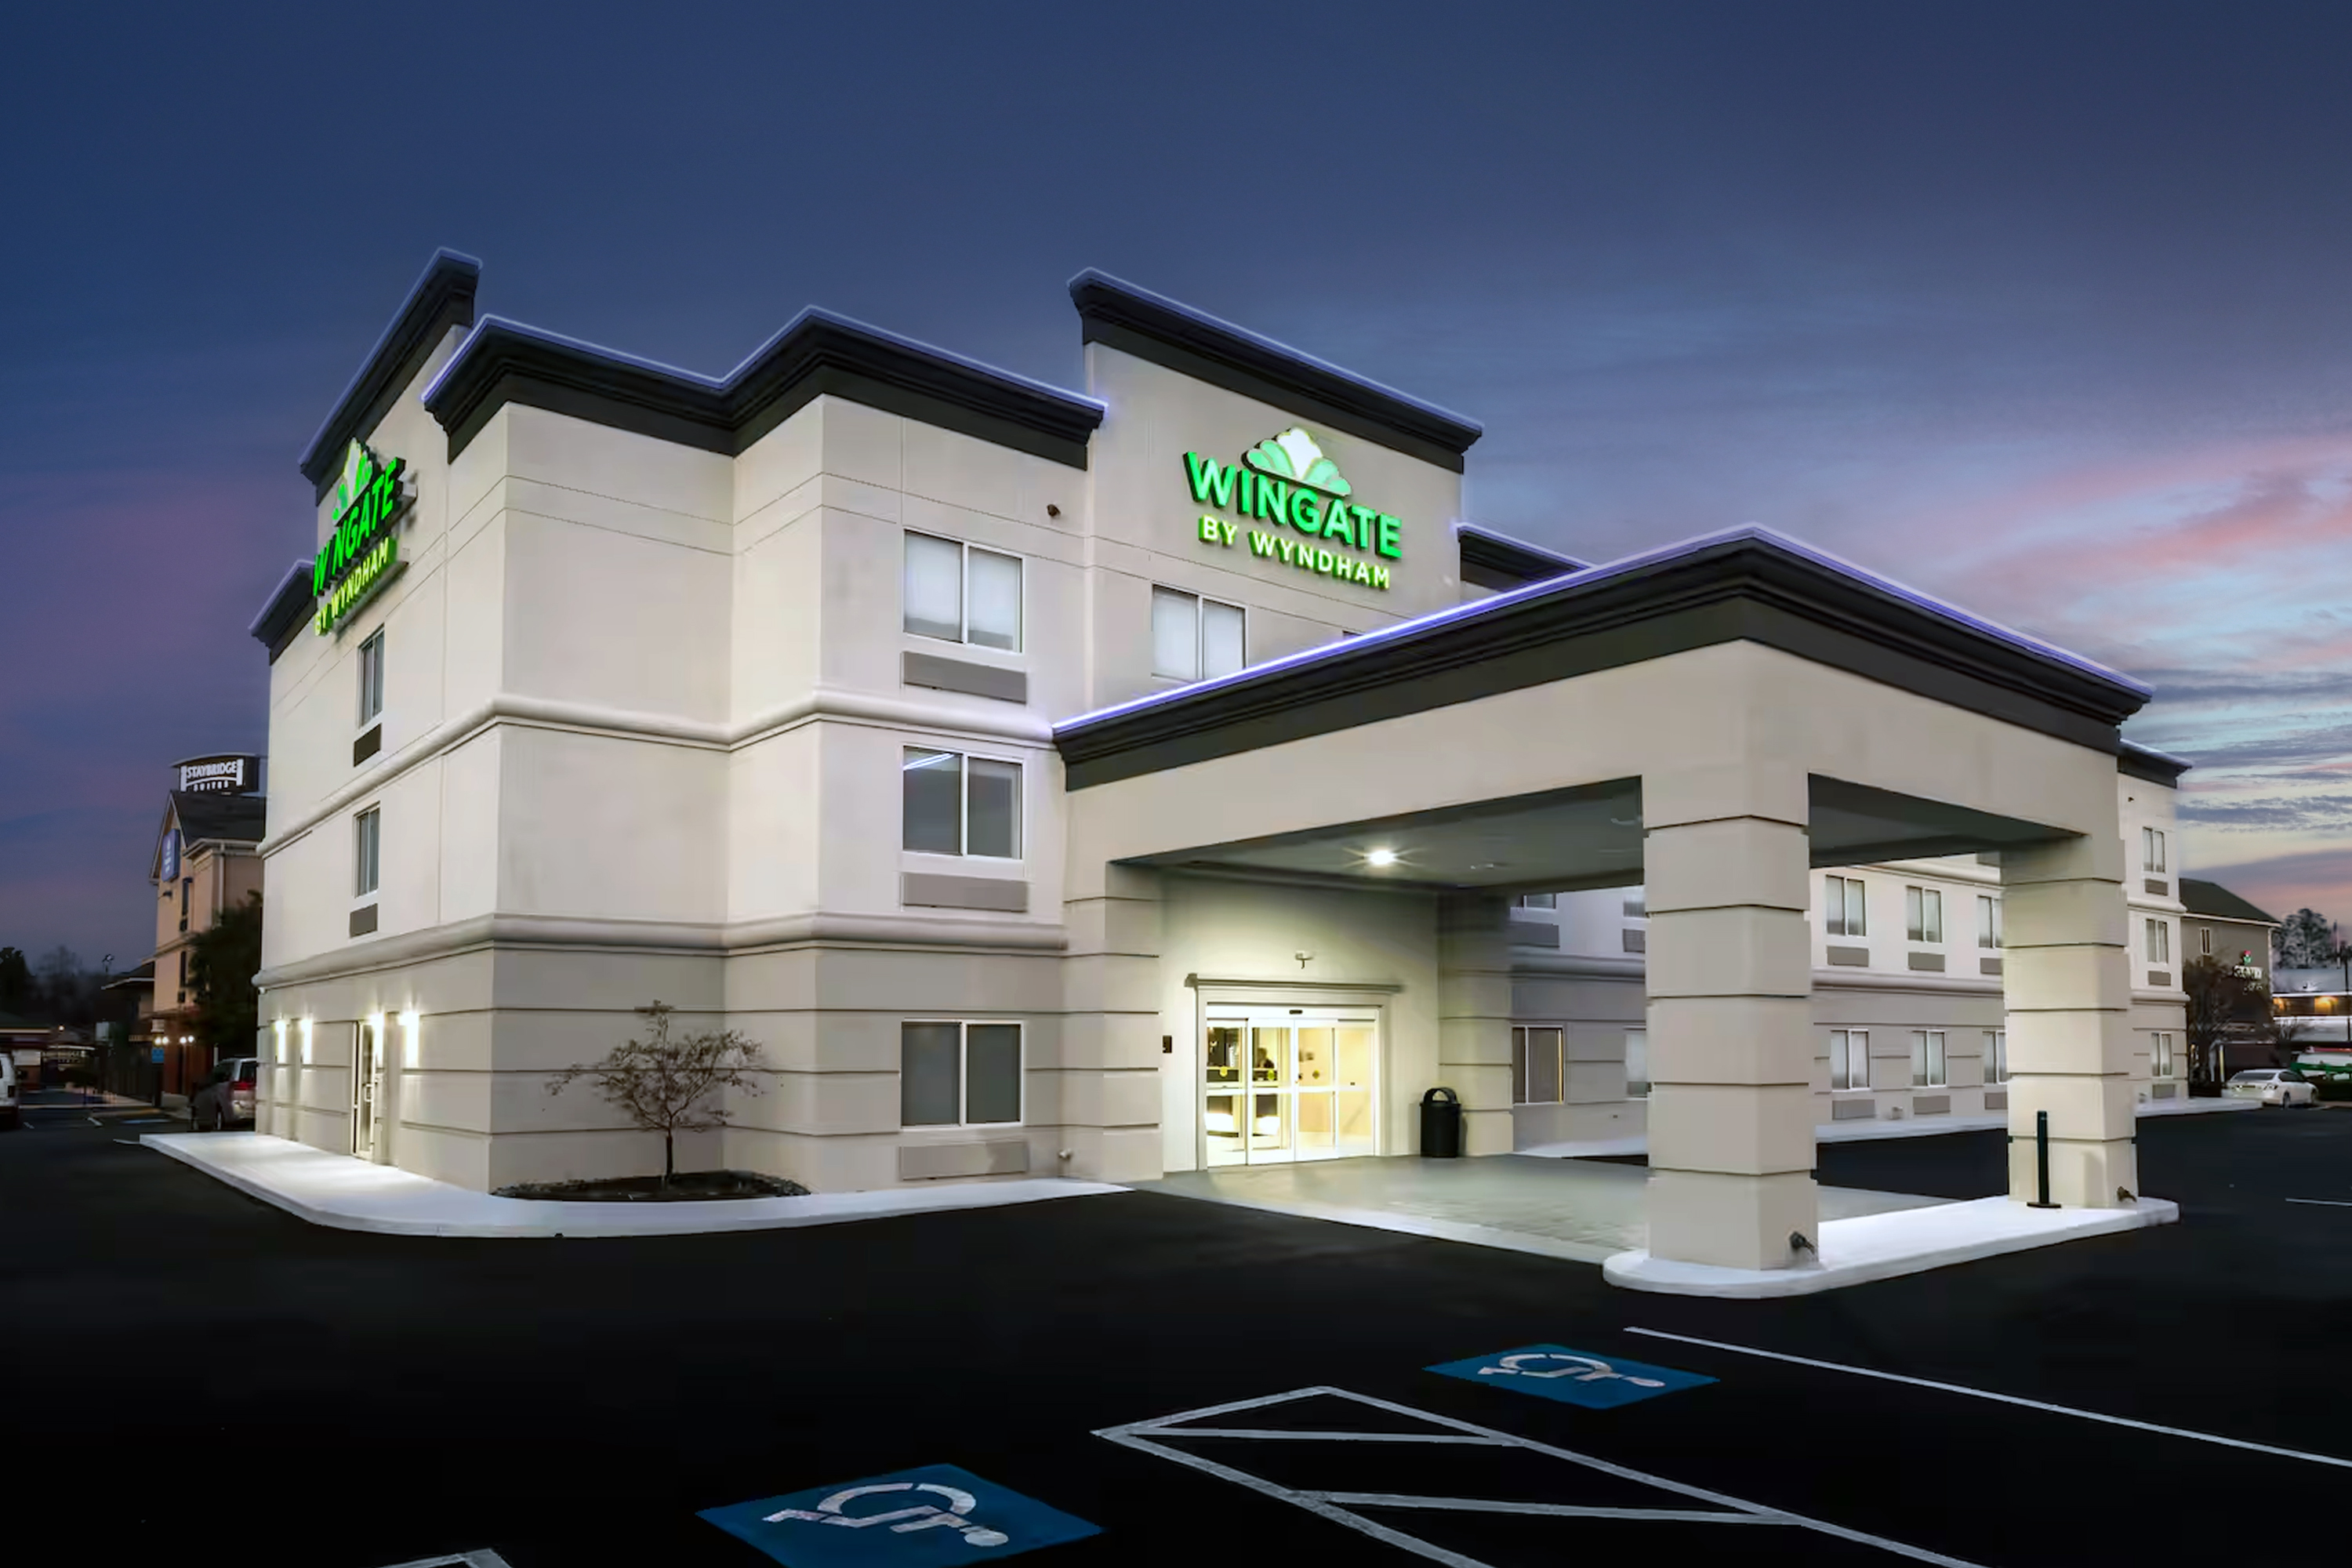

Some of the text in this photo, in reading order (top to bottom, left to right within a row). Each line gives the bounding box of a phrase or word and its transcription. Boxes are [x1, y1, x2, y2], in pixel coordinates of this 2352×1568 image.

[1183, 451, 1403, 559] WINGATE
[315, 536, 391, 637] BY WYNDHAM
[1199, 514, 1390, 589] BY WYNDHAM
[187, 760, 238, 779] STAYBRIDGE
